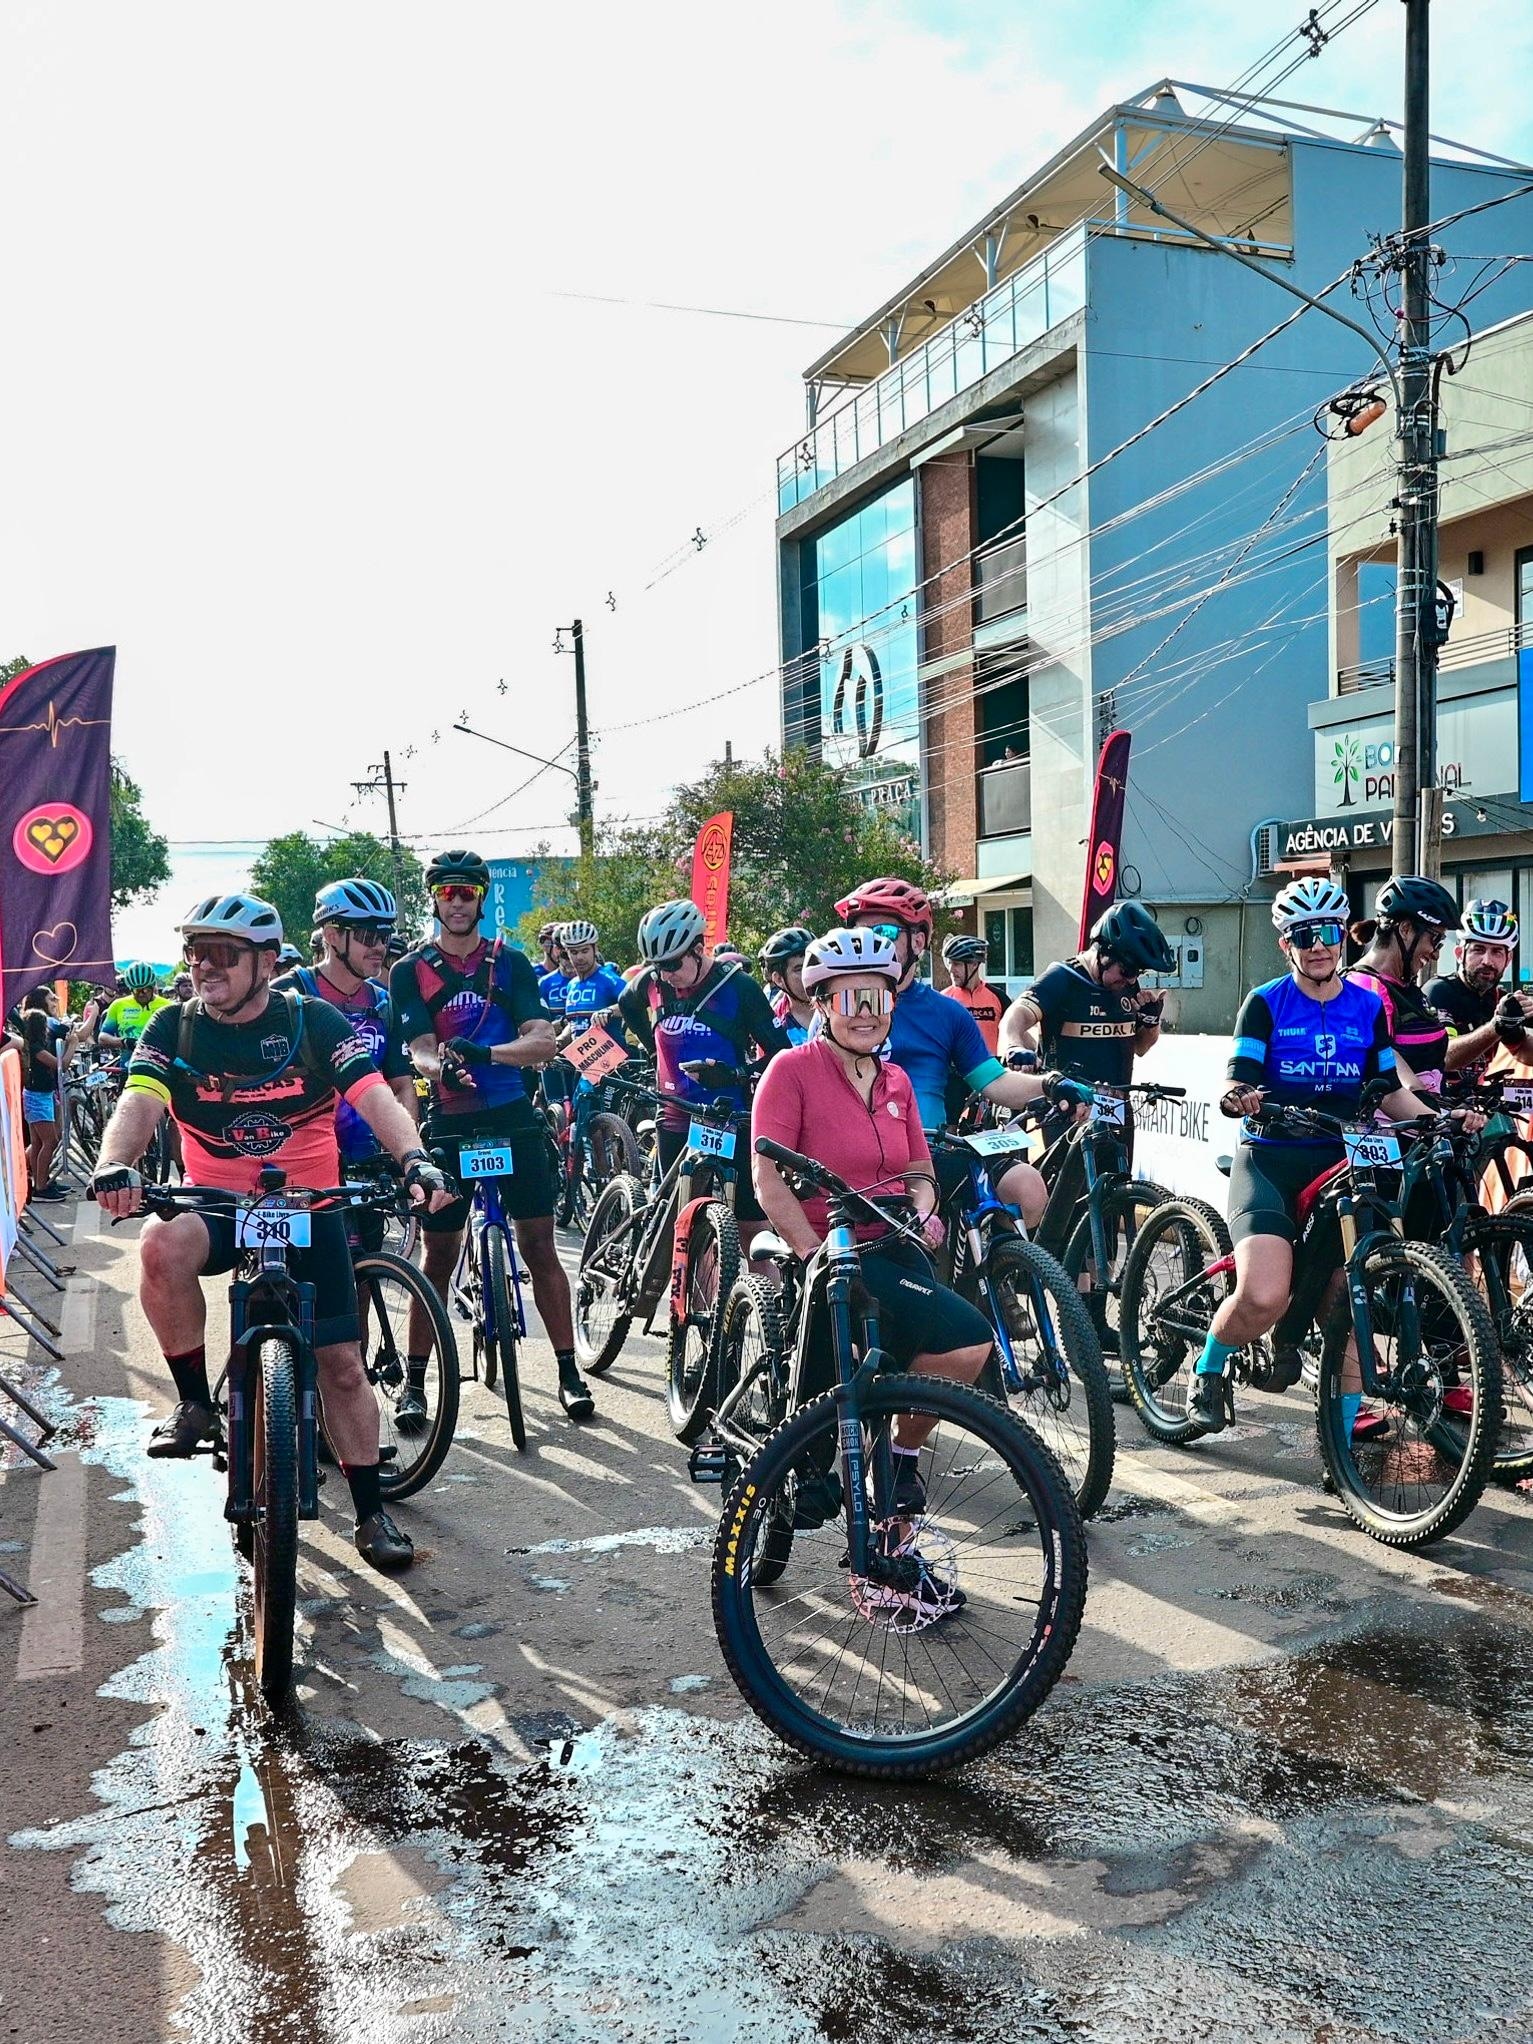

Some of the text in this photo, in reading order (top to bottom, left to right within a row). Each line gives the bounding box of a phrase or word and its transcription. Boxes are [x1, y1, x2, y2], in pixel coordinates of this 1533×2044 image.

[1286, 823, 1348, 852] AGÊNCIA
[1353, 823, 1374, 844] DE
[570, 989, 596, 1002] OCI
[1080, 1024, 1127, 1036] PEDAL
[577, 1037, 597, 1055] PRO
[578, 1040, 615, 1071] MASCULINO
[1180, 1100, 1211, 1142] BIKE
[700, 1133, 723, 1151] 316
[987, 1139, 1020, 1150] 305
[470, 1156, 505, 1172] 3103
[256, 1221, 291, 1240] 340
[851, 1460, 863, 1512] PSYLO
[725, 1484, 756, 1576] MAXXIS
